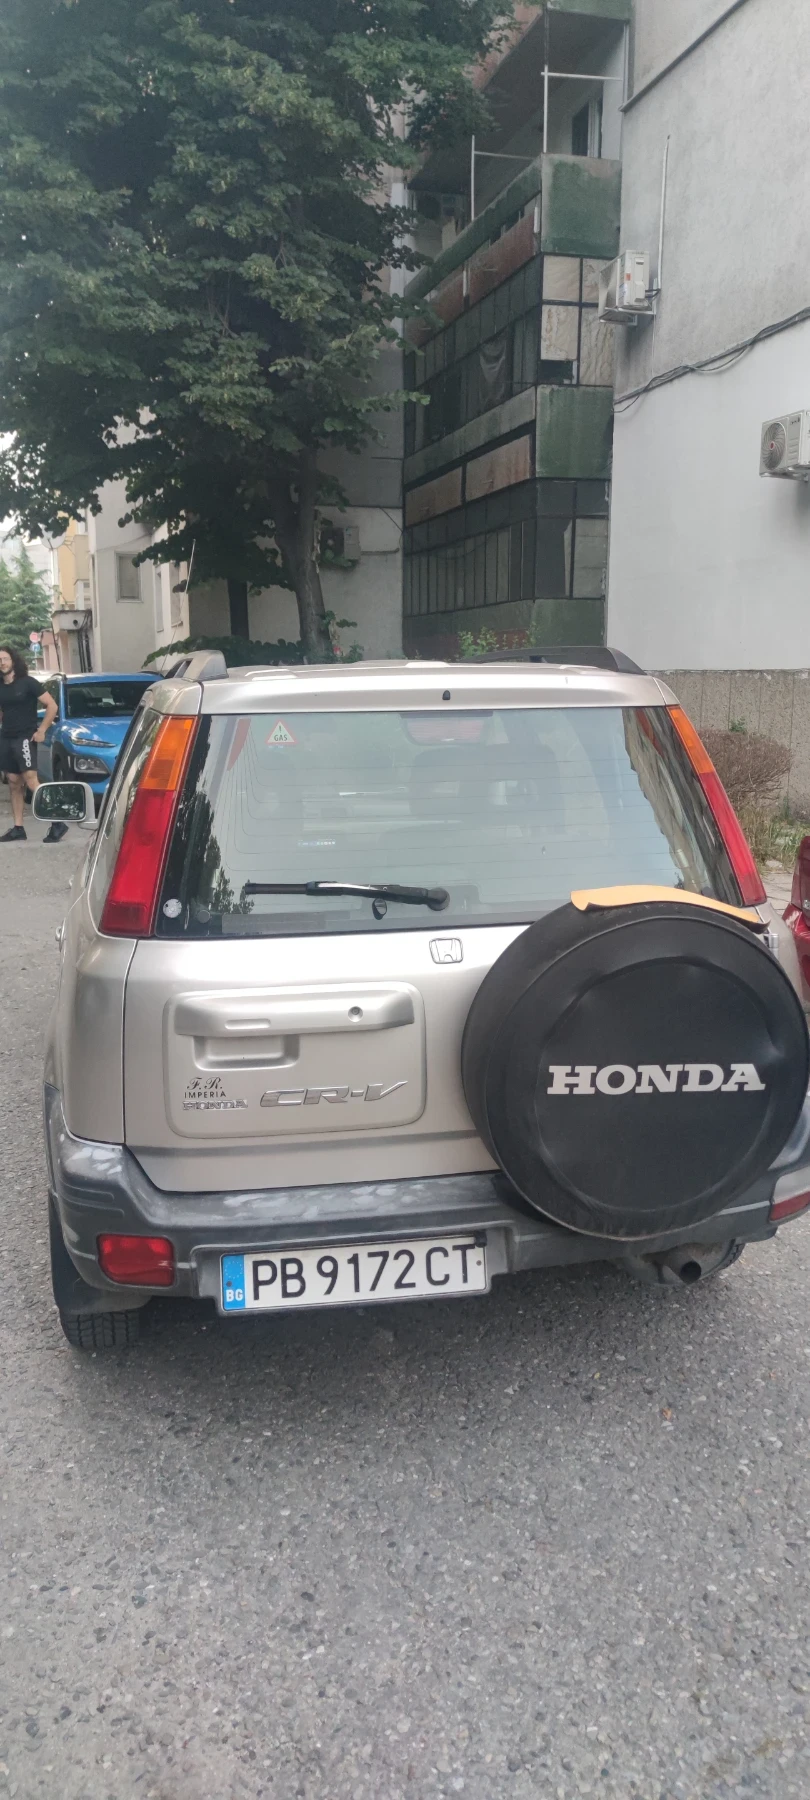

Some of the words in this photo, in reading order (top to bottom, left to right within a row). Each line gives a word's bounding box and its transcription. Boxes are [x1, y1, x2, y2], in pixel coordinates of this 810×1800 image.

[273, 734, 288, 742] GAS
[21, 738, 32, 768] adidas
[546, 1063, 766, 1096] HONDA
[184, 1090, 227, 1099] IMPERIA
[260, 1080, 408, 1108] CR-V
[182, 1099, 249, 1111] HONDA
[252, 1257, 306, 1301] PB
[316, 1249, 416, 1295] 9172
[425, 1243, 476, 1286] CT
[225, 1289, 244, 1302] BG
